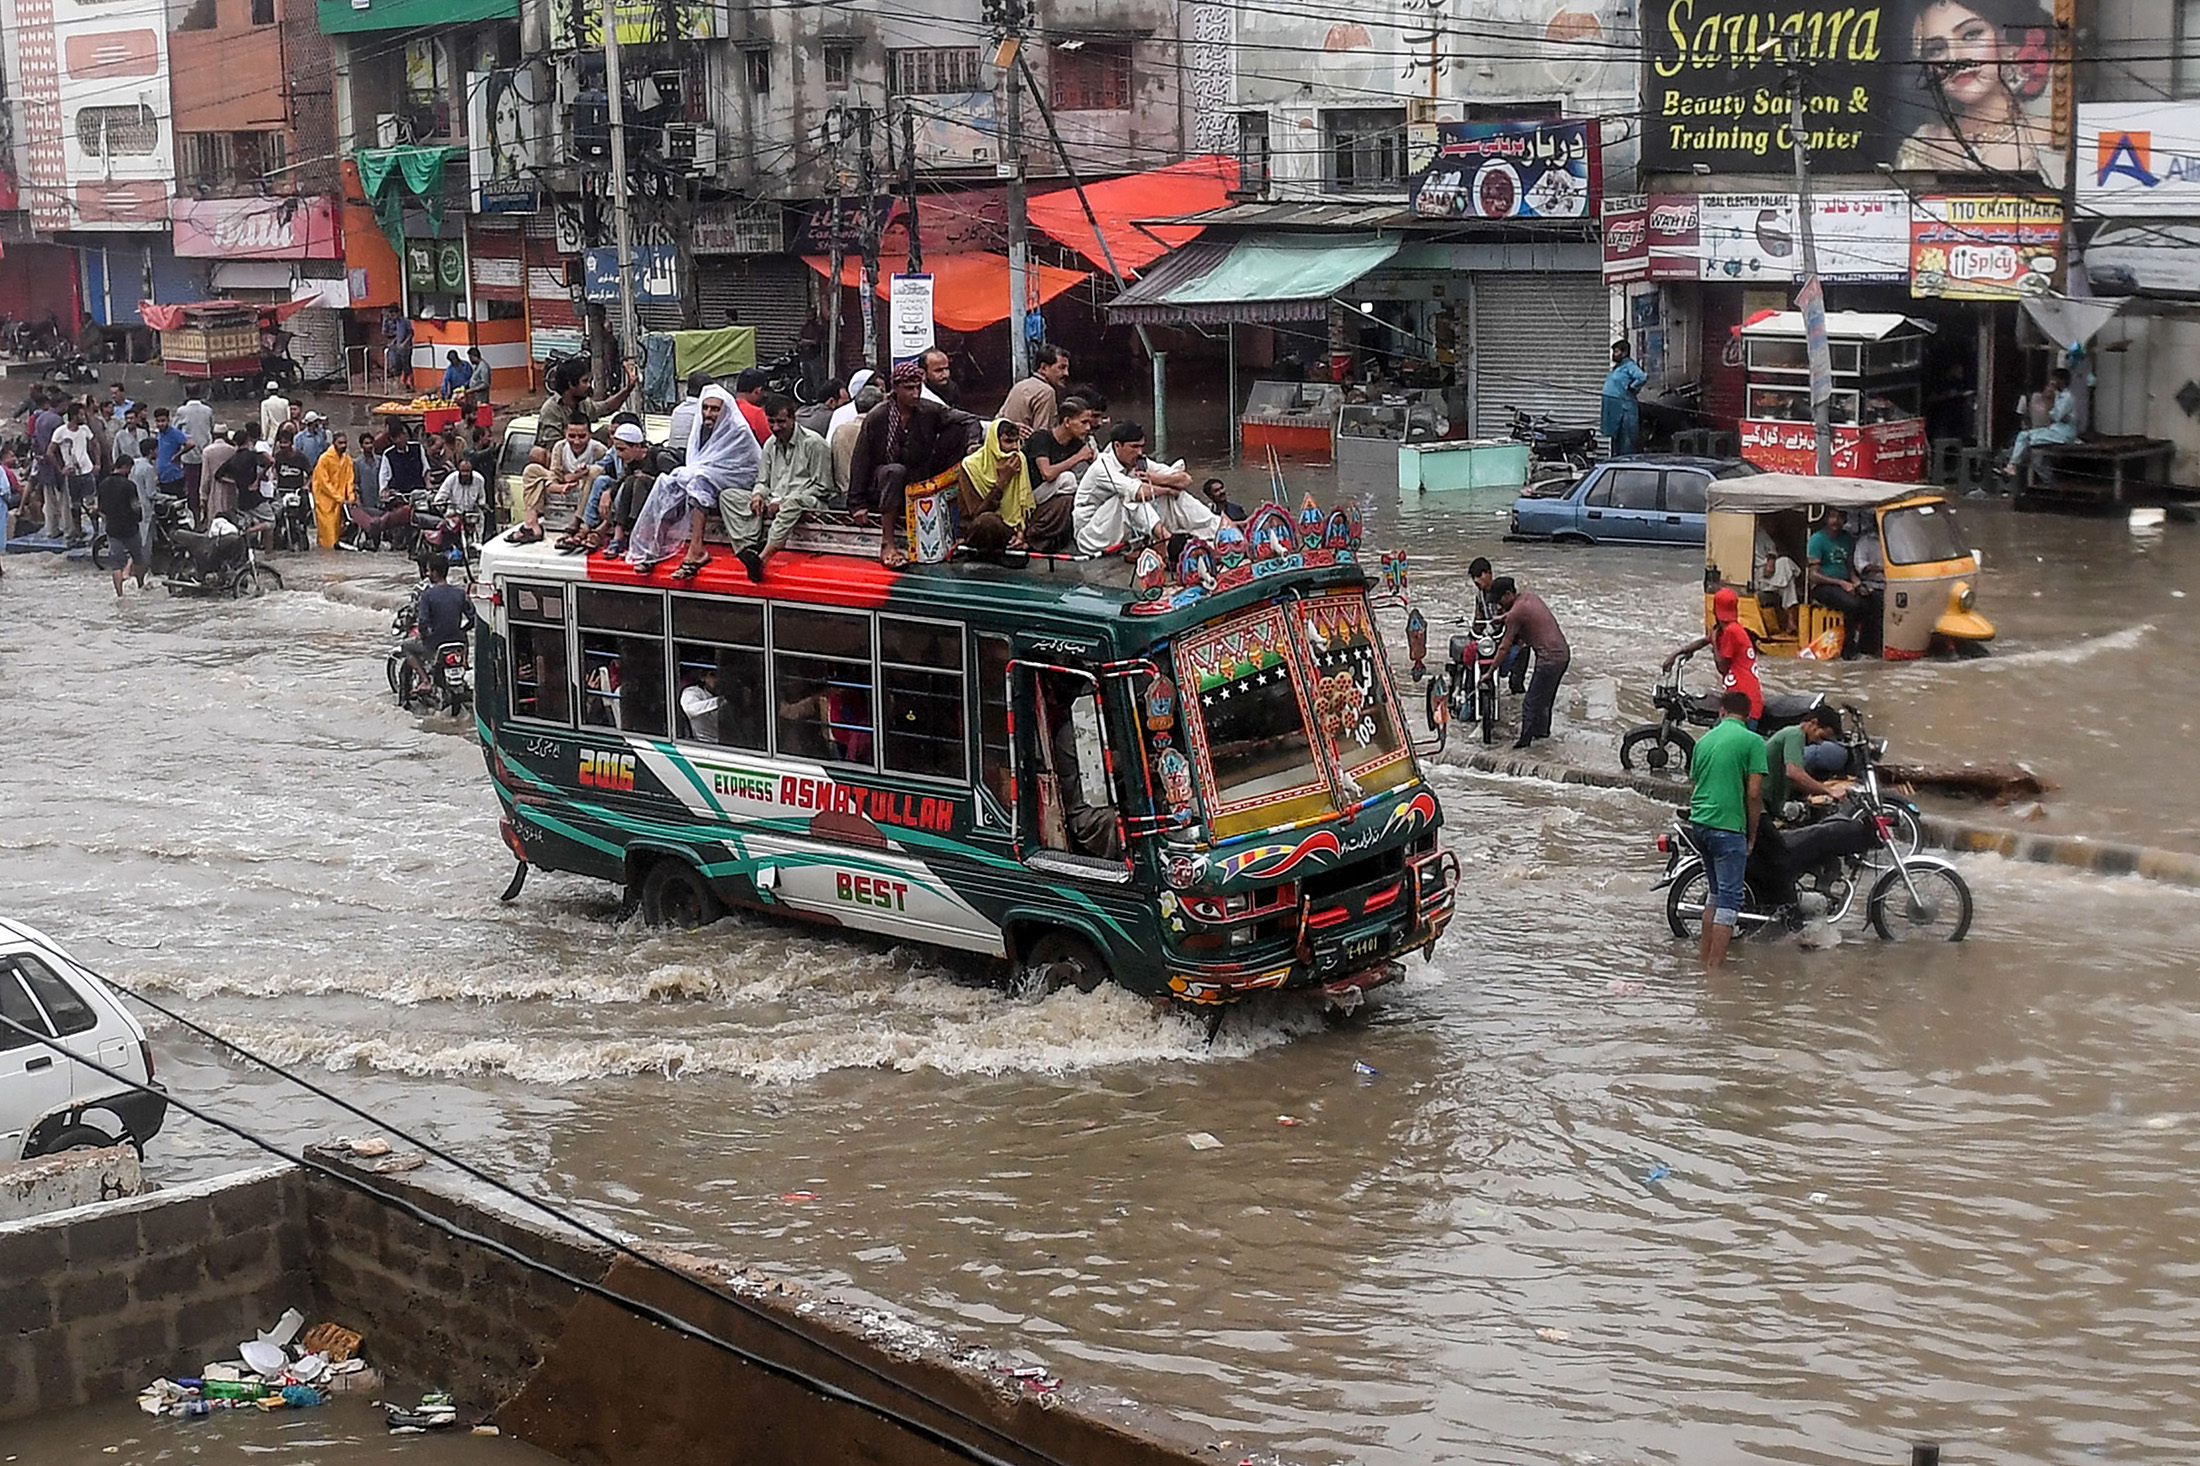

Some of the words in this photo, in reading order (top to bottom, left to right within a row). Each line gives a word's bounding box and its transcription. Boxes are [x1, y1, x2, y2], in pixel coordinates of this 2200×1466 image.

[1662, 90, 1746, 120] Beauty
[1848, 86, 1870, 113] &
[1522, 126, 1586, 167] دربار
[1669, 123, 1770, 155] Training
[1726, 195, 1760, 207] ELECTRO
[1761, 194, 1789, 207] PALACE
[1951, 202, 1975, 219] 110
[1978, 201, 2062, 218] CHATKHARA
[1651, 213, 1697, 228] WAHID
[1969, 253, 2013, 273] Spicy
[1354, 715, 1376, 749] 108
[579, 748, 636, 790] 2016
[714, 773, 773, 802] EXPRESS
[780, 775, 954, 832] ASMATULLAH
[836, 871, 908, 912] BEST
